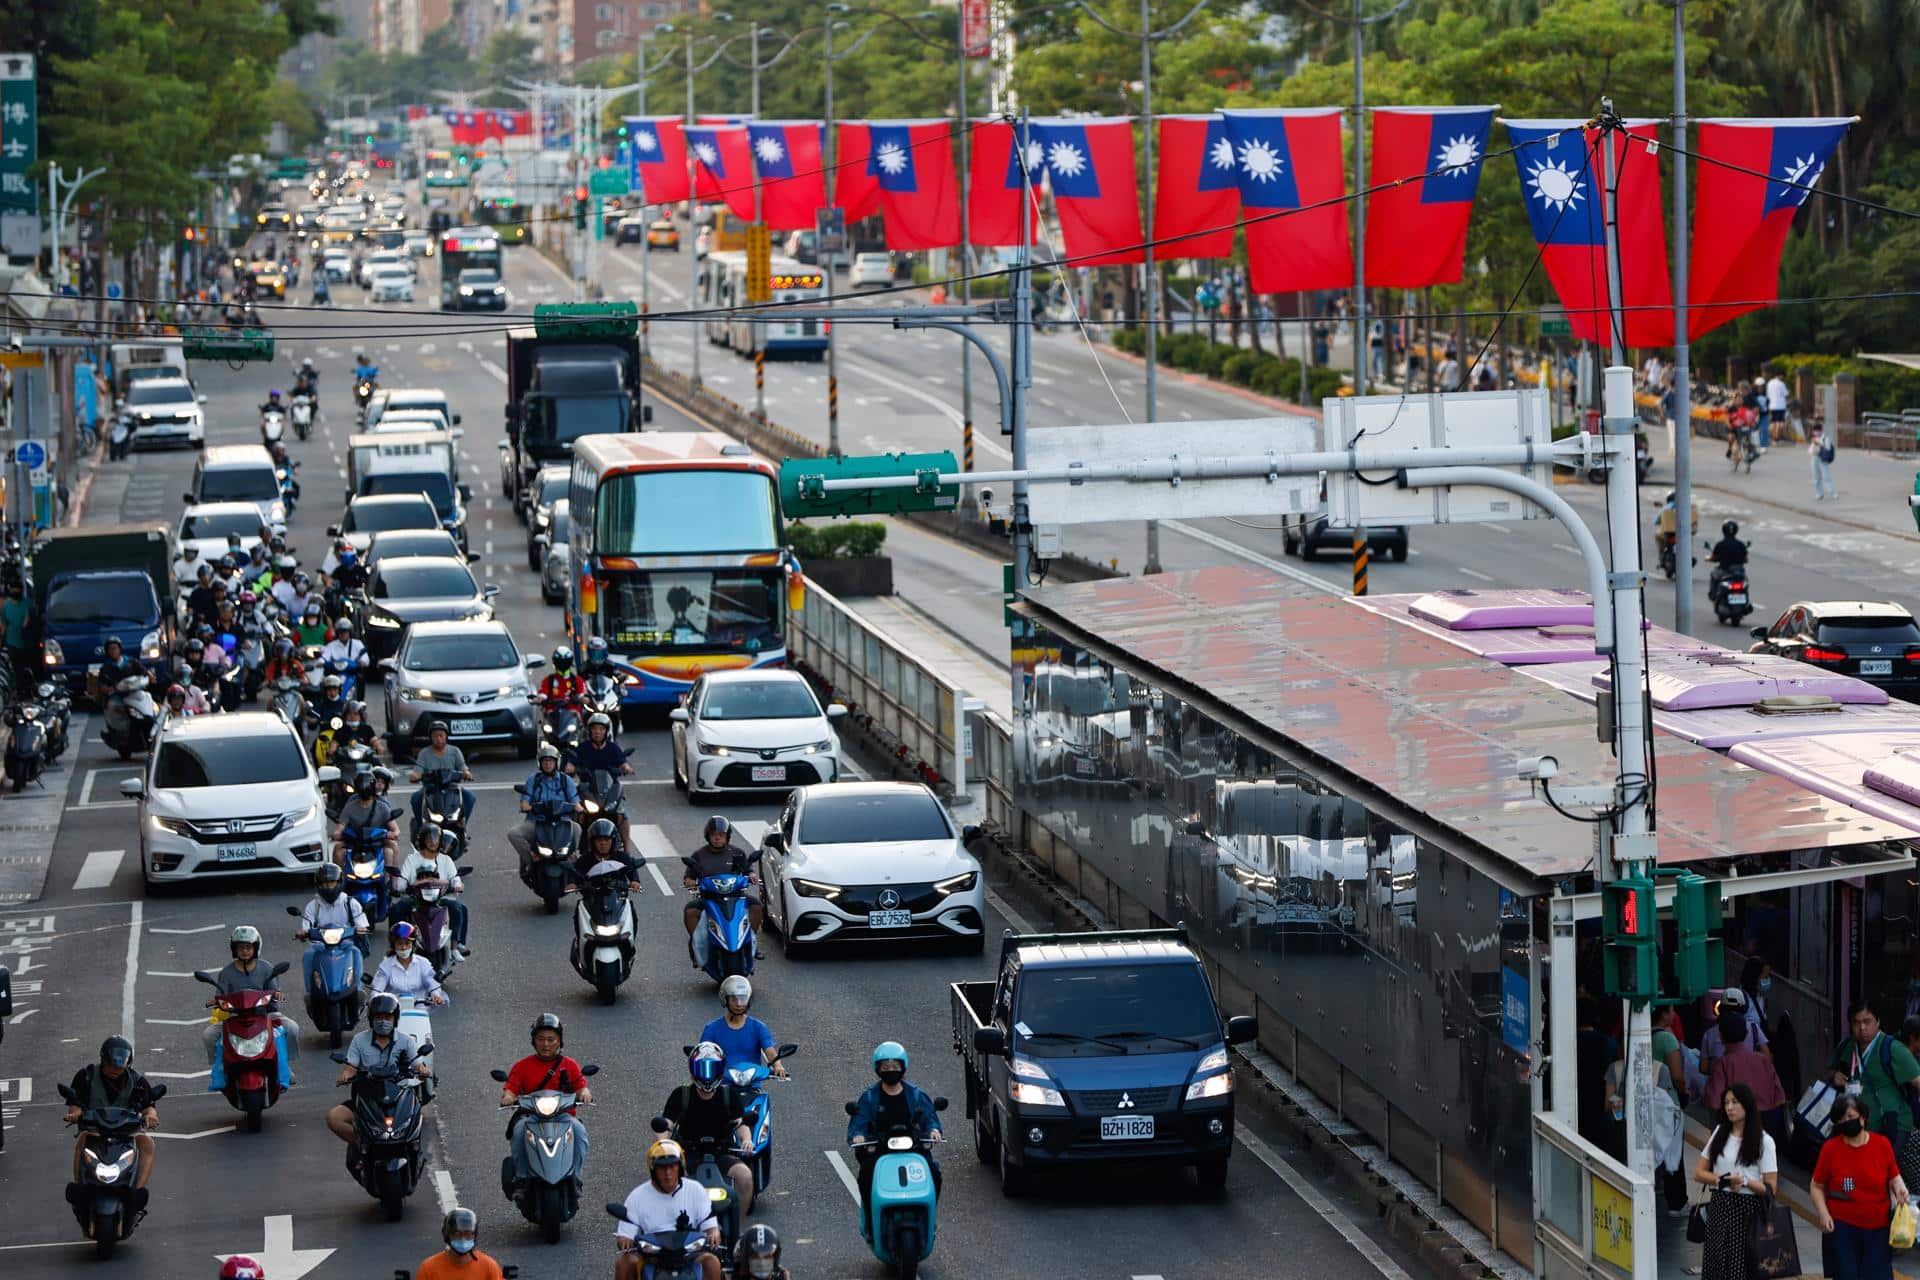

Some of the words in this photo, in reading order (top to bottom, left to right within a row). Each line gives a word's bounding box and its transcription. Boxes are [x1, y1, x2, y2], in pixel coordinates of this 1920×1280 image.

[2, 101, 31, 217] 博士眼
[1102, 1121, 1153, 1137] BZH-1828
